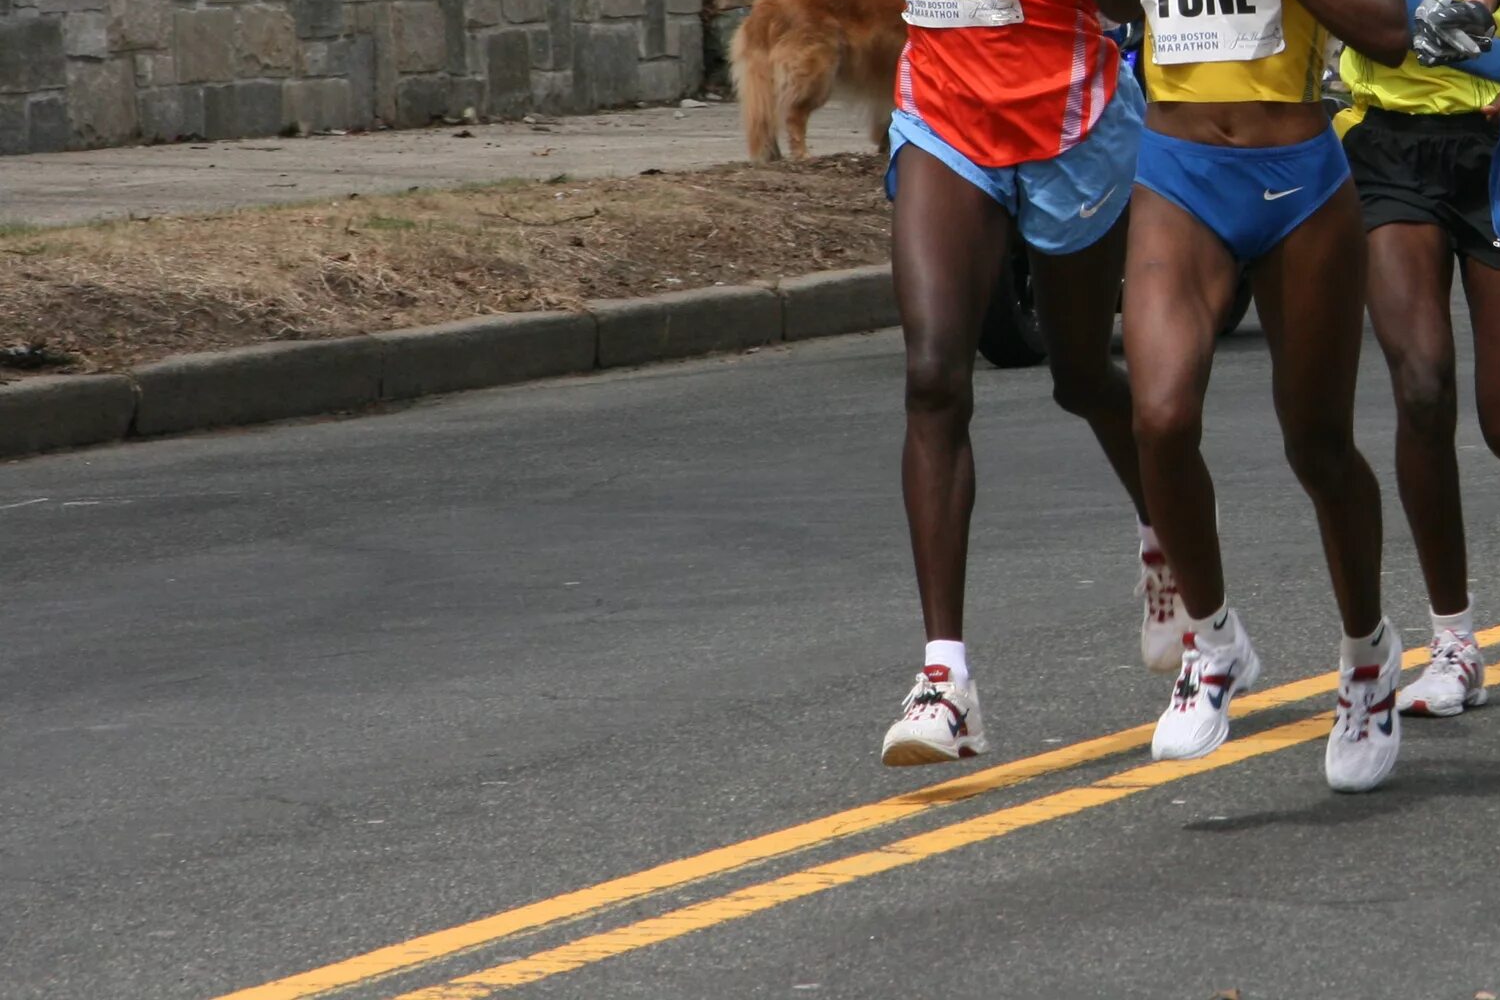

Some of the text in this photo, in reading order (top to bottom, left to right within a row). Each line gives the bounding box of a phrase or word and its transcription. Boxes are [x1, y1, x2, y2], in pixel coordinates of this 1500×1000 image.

[927, 1, 958, 9] BOSTON
[914, 8, 959, 19] MARATHON
[1157, 32, 1218, 42] 2009 BOSTON
[1157, 41, 1219, 52] MARATHON
